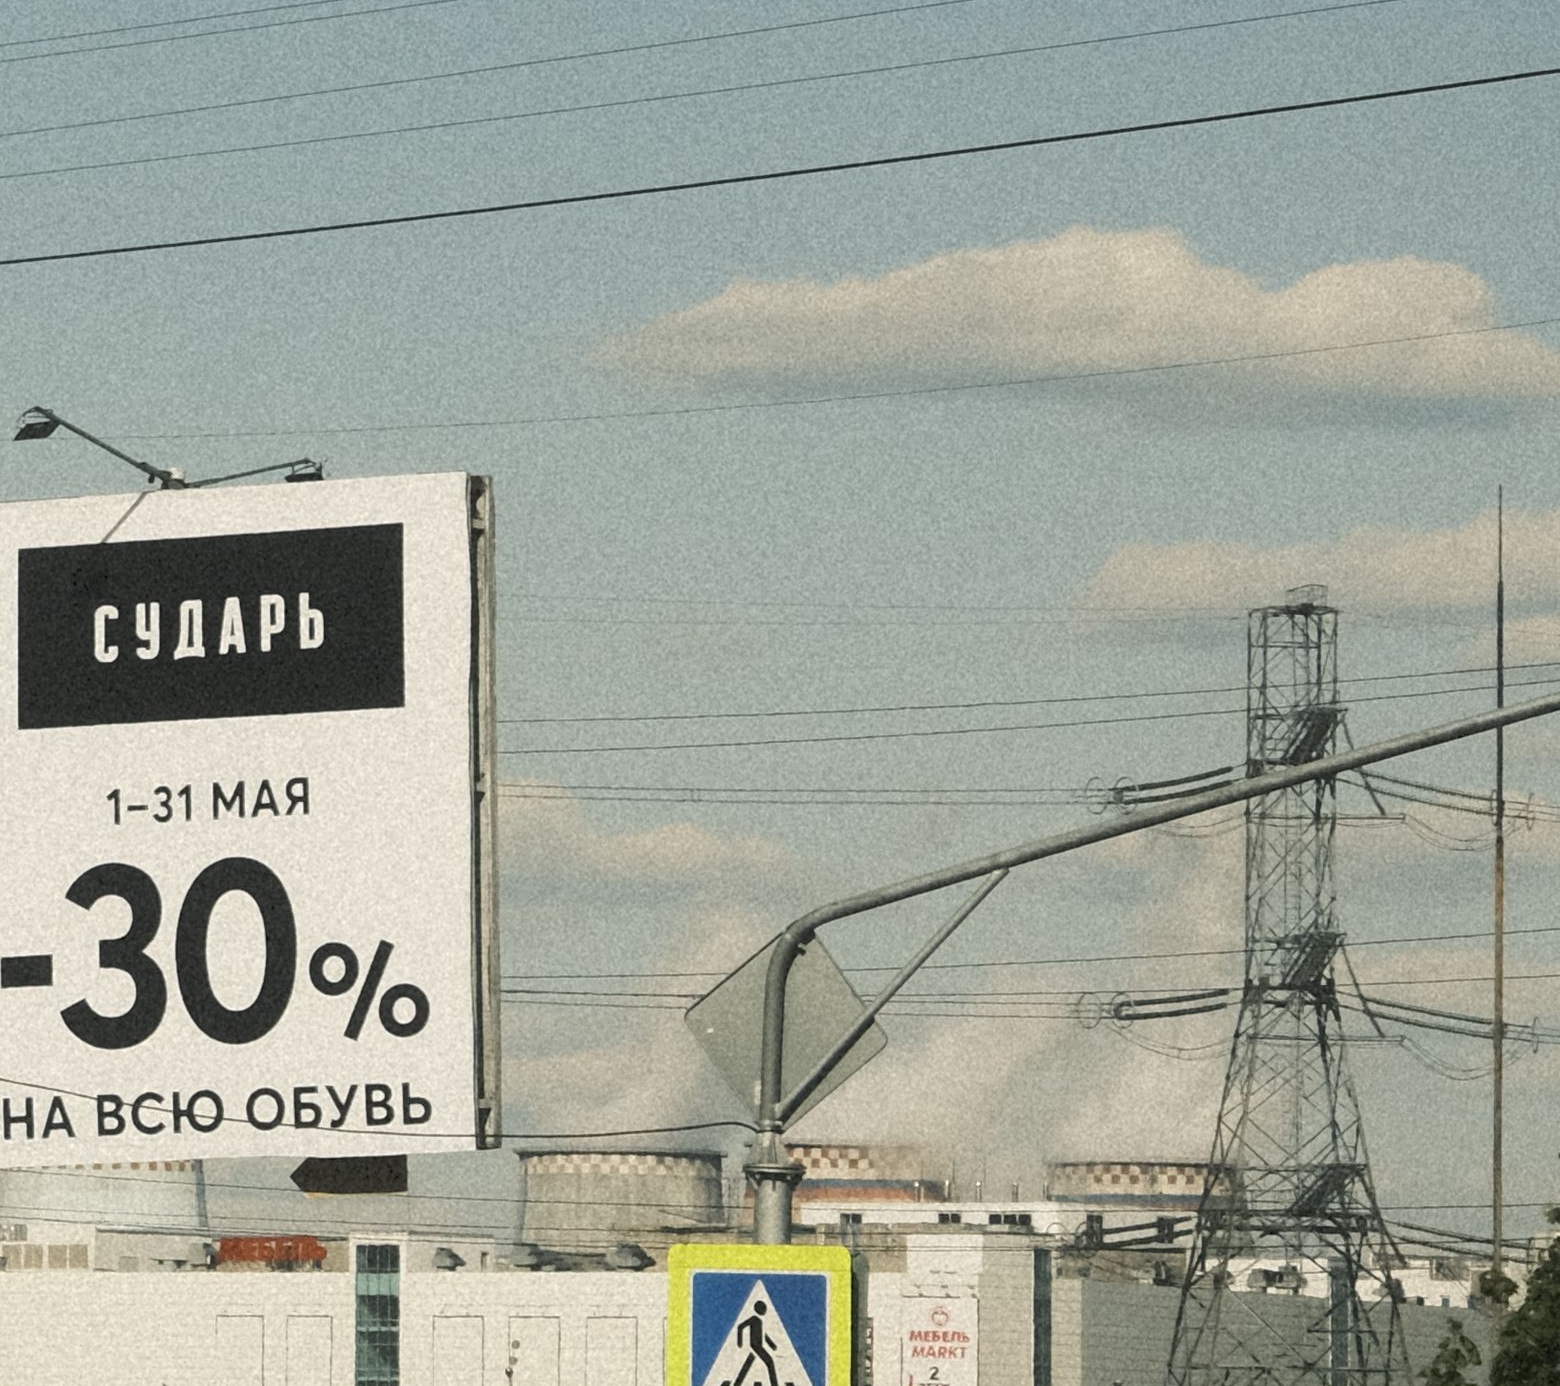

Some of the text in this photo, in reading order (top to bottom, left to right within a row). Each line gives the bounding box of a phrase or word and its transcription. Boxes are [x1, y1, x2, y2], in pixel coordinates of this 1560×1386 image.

[93, 591, 325, 664] СУДАРЬ
[106, 776, 311, 826] 1-31 МАЯ
[0, 856, 431, 1050] -30%
[1, 1081, 433, 1141] НА ВСЮ ОБУВЬ
[908, 1329, 971, 1343] МЕБЕЛЬ
[929, 1365, 940, 1381] 2
